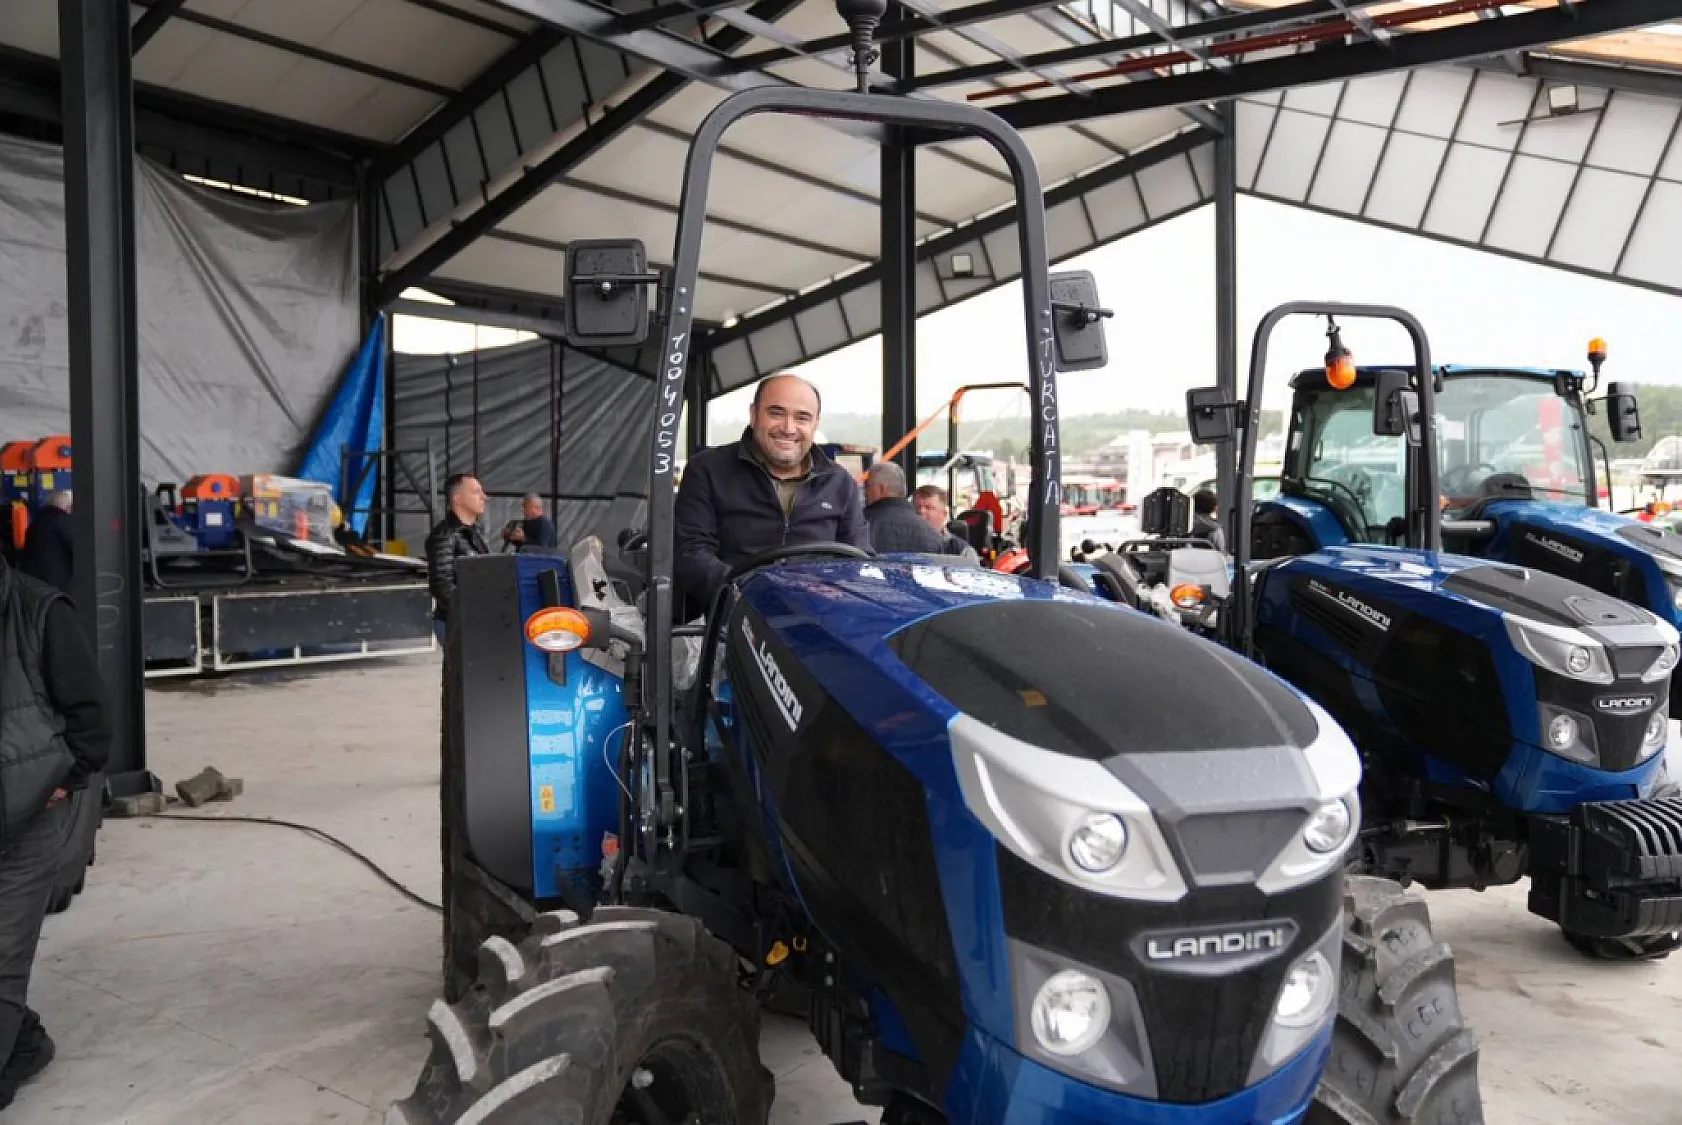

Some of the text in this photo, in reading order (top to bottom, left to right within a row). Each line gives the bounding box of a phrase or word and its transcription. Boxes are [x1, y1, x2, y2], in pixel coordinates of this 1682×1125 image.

[1338, 591, 1391, 626] LANDINI
[759, 640, 803, 723] LANDINI
[1599, 698, 1652, 708] LANDINI
[1148, 928, 1284, 959] LANDINI
